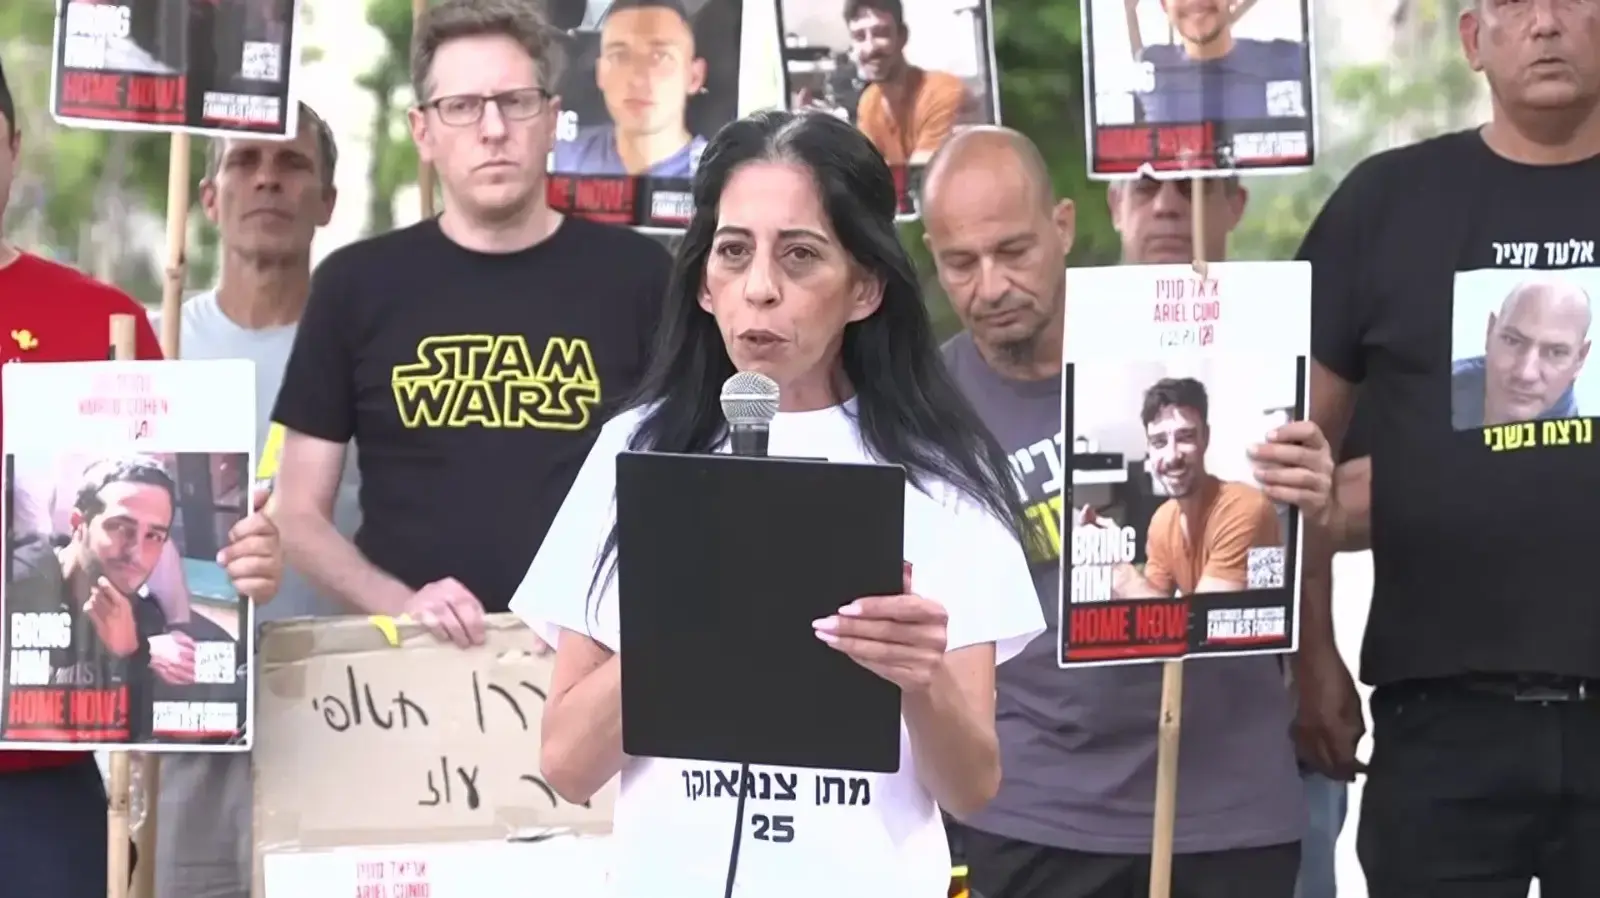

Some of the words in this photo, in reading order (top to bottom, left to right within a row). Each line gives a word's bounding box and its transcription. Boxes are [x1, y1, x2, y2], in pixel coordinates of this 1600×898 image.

[1492, 241, 1539, 268] קציר
[1543, 238, 1595, 265] אלעד
[1153, 302, 1188, 323] ARIEL
[391, 334, 600, 384] STAM
[391, 379, 601, 430] WARS
[1483, 422, 1537, 452] בשבי
[1542, 417, 1593, 446] נרצח
[1070, 526, 1136, 566] BRING
[1070, 565, 1112, 604] HIM
[1070, 606, 1130, 643] HOME
[8, 690, 66, 725] HOME
[70, 686, 129, 727] NOW!
[682, 769, 798, 801] צנגאוקו
[815, 774, 871, 806] מתן
[751, 813, 795, 843] 25
